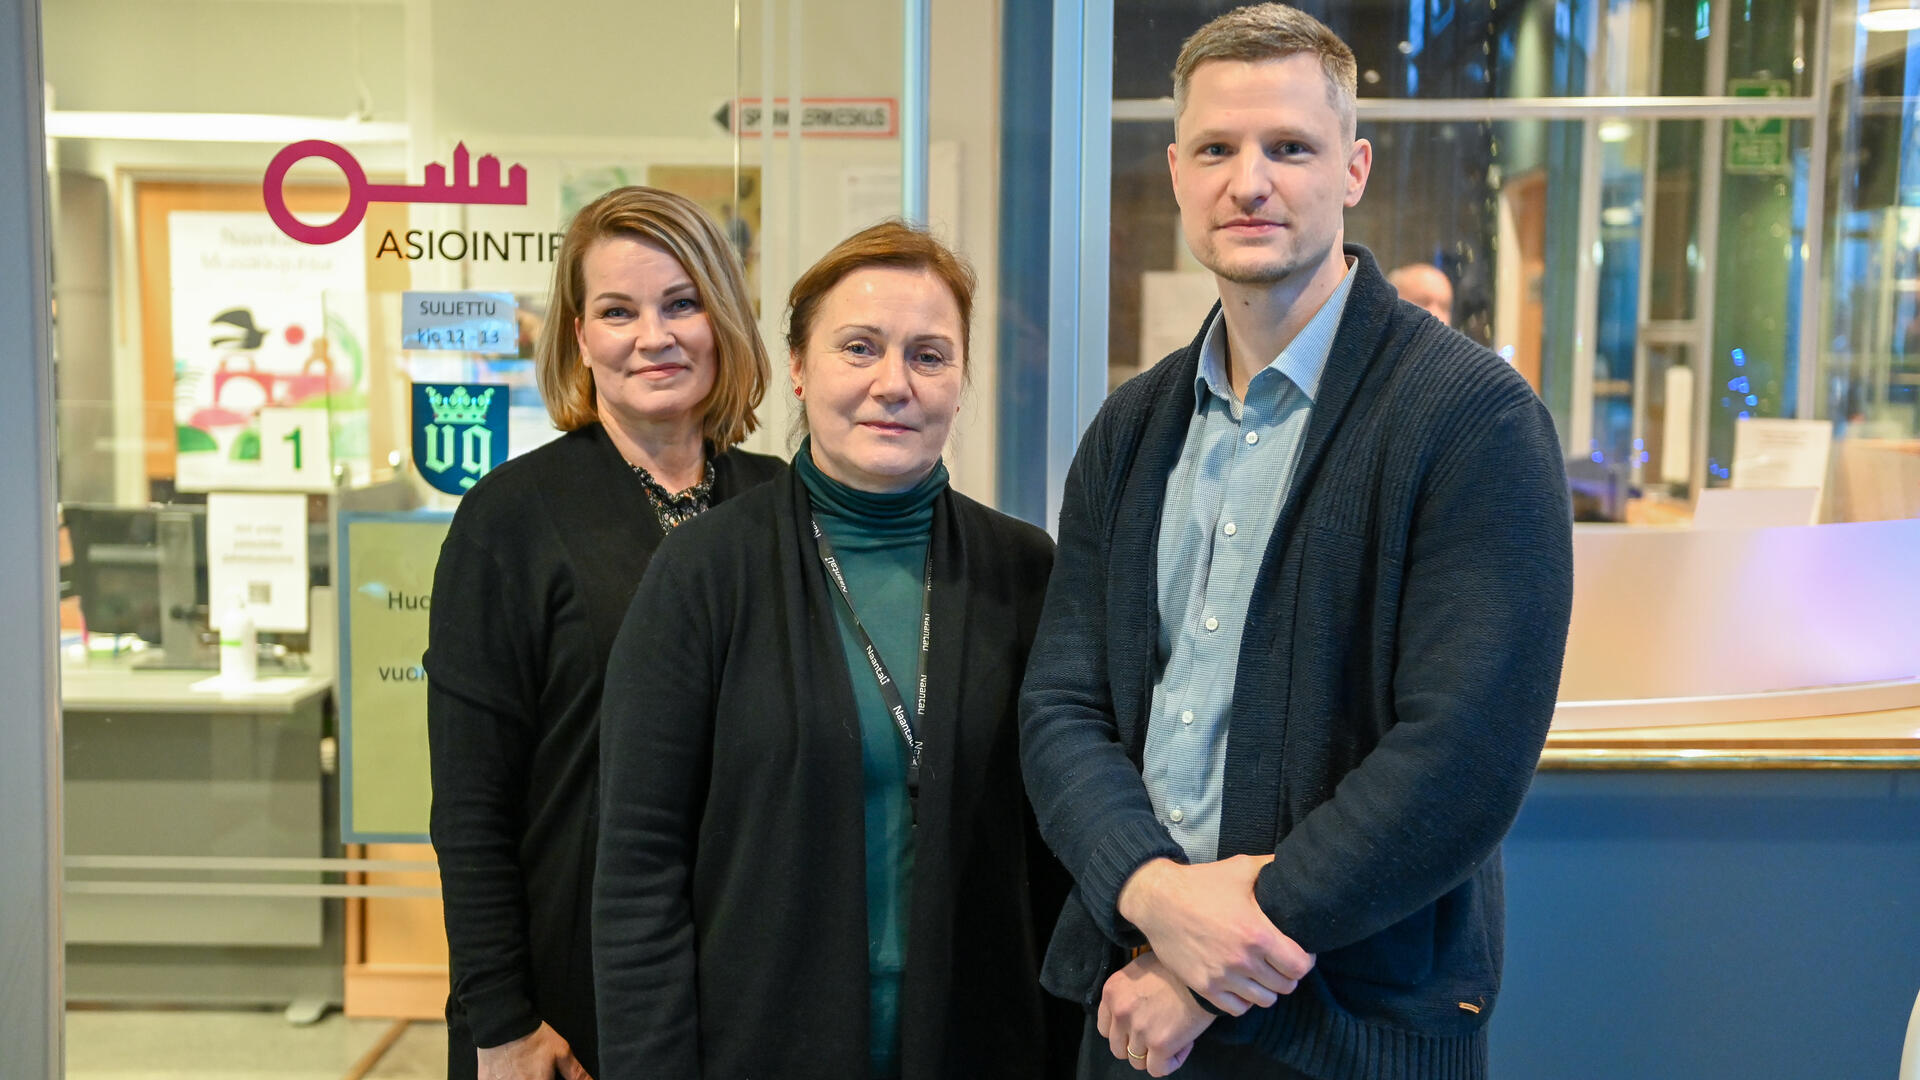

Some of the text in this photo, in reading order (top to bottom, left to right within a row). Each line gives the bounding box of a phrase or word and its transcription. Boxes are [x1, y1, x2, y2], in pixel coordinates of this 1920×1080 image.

[420, 301, 496, 316] SULJETTU
[448, 330, 464, 344] 12
[480, 330, 499, 344] 13
[283, 427, 302, 470] 1
[866, 644, 891, 686] Naantali
